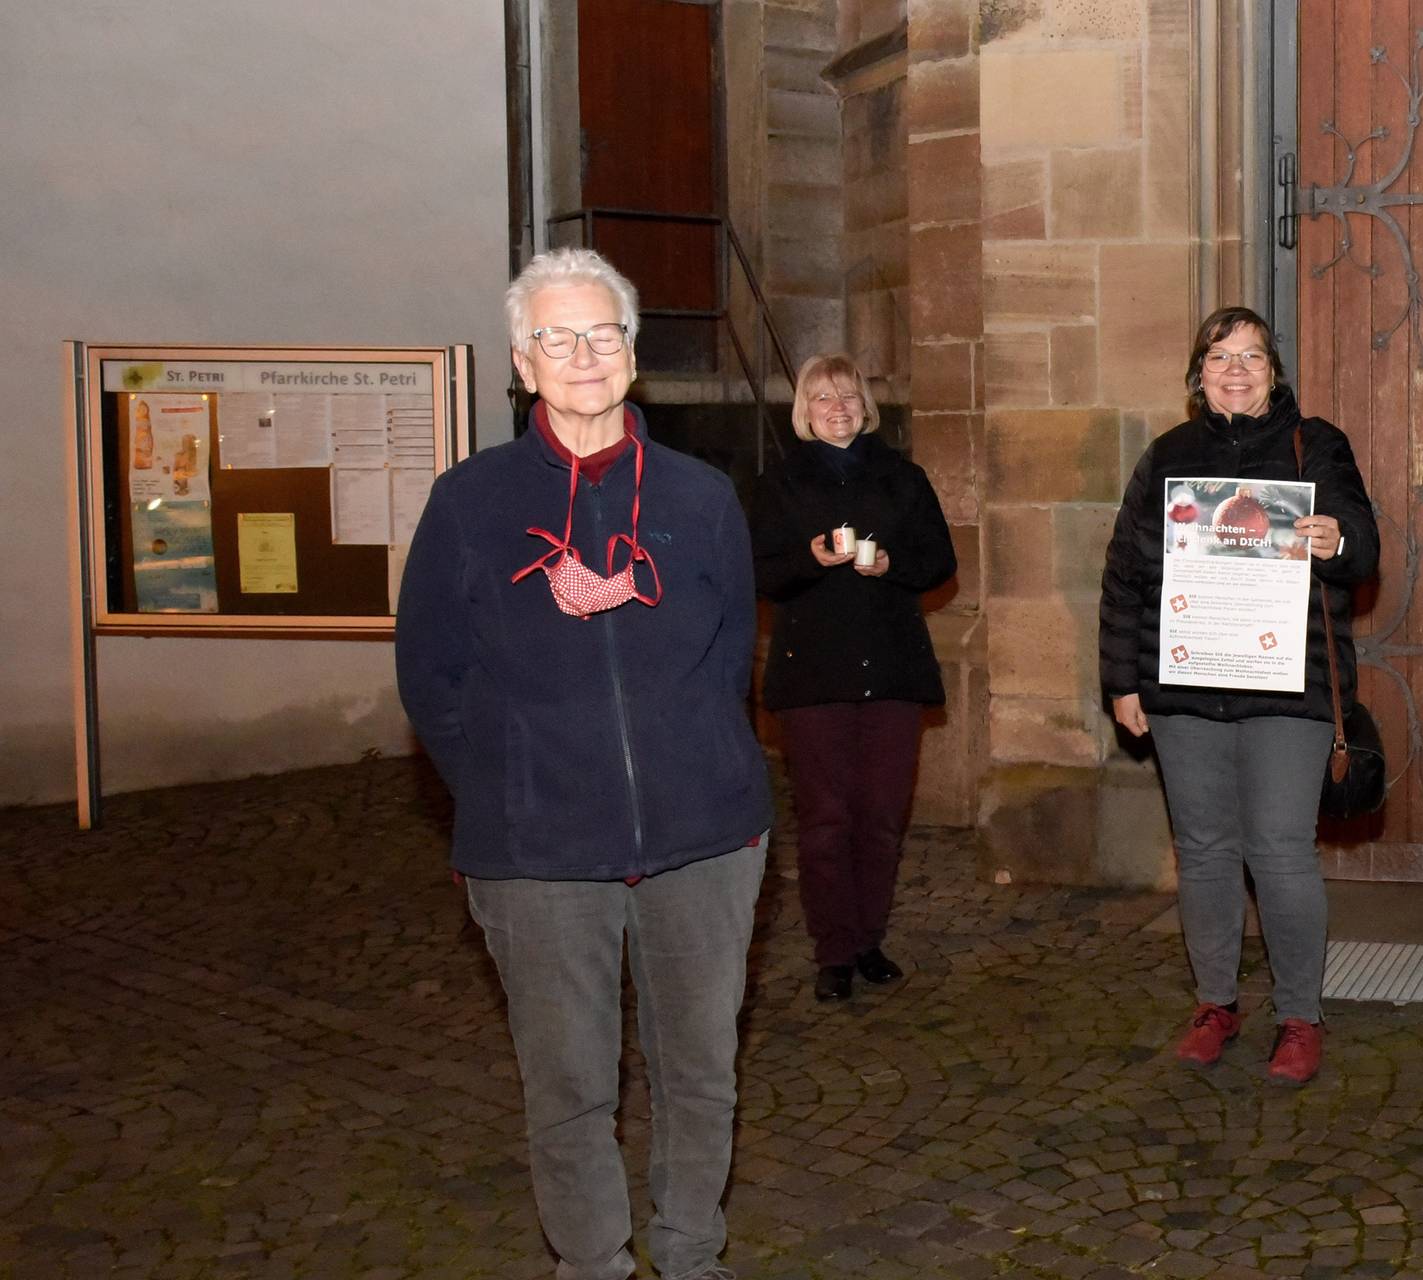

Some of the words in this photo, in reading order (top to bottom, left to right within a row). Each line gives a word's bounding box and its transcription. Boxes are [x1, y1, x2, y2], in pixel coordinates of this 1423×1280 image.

[189, 371, 224, 383] PETRI
[260, 371, 349, 385] Pfarrkirche
[353, 371, 374, 385] St.
[379, 371, 417, 386] Petri
[1223, 538, 1236, 546] an
[1240, 538, 1272, 548] DICH!
